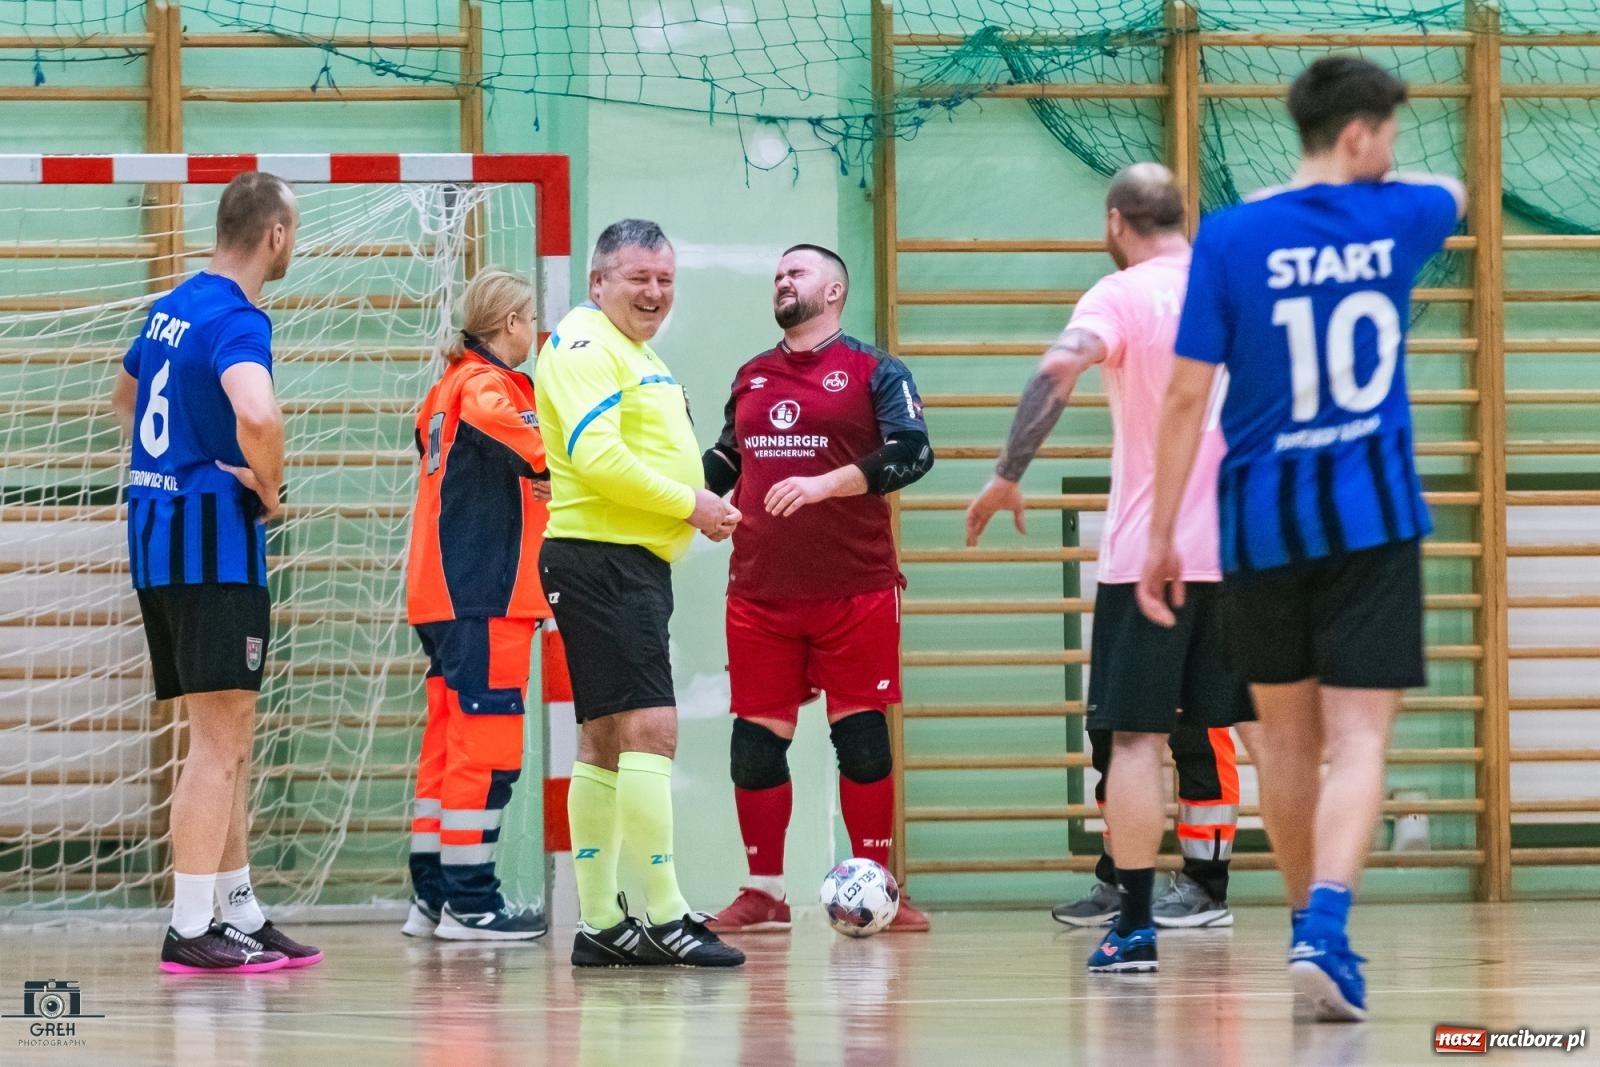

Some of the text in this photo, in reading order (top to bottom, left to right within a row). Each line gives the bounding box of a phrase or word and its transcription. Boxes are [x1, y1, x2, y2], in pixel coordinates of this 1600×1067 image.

[1266, 238, 1394, 289] START
[1272, 289, 1401, 423] 10
[139, 358, 170, 459] 6
[744, 435, 829, 449] NÜRNBERGER
[754, 449, 816, 459] VERSICHERUNG
[843, 870, 877, 902] SELECT
